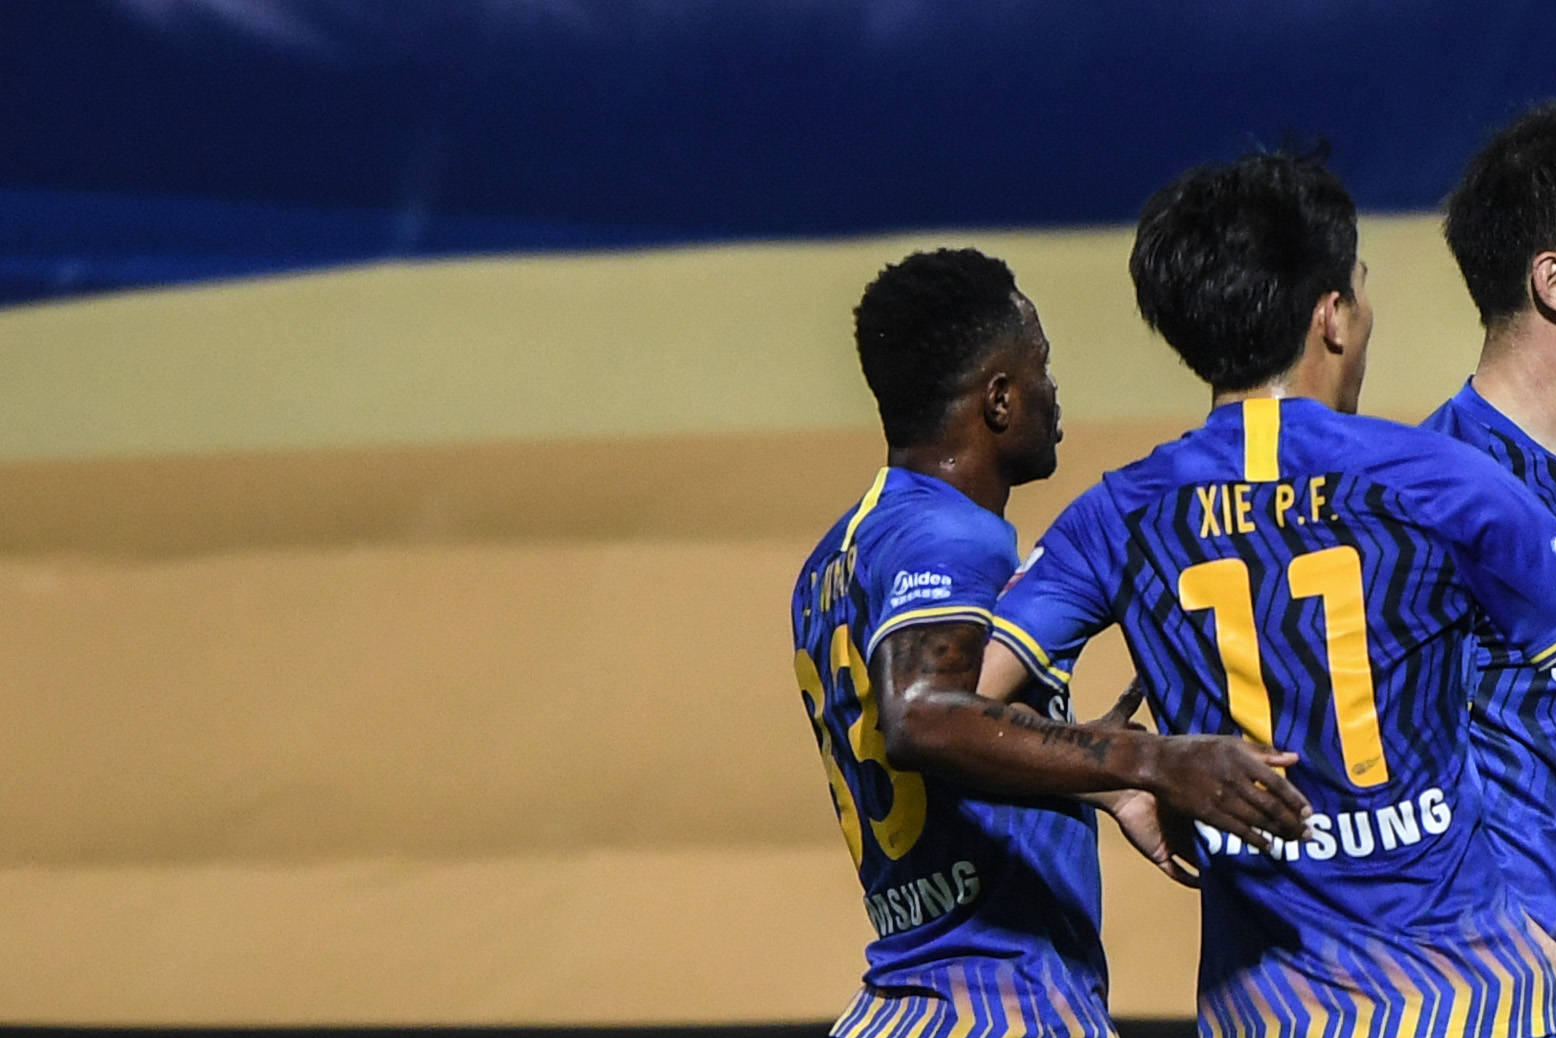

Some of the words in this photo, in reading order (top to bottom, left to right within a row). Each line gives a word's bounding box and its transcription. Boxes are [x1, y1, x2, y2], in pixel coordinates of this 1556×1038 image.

[1197, 485, 1255, 538] XIE
[1275, 476, 1339, 528] P.F.
[1178, 545, 1390, 788] 11
[863, 860, 981, 938] MSUNG
